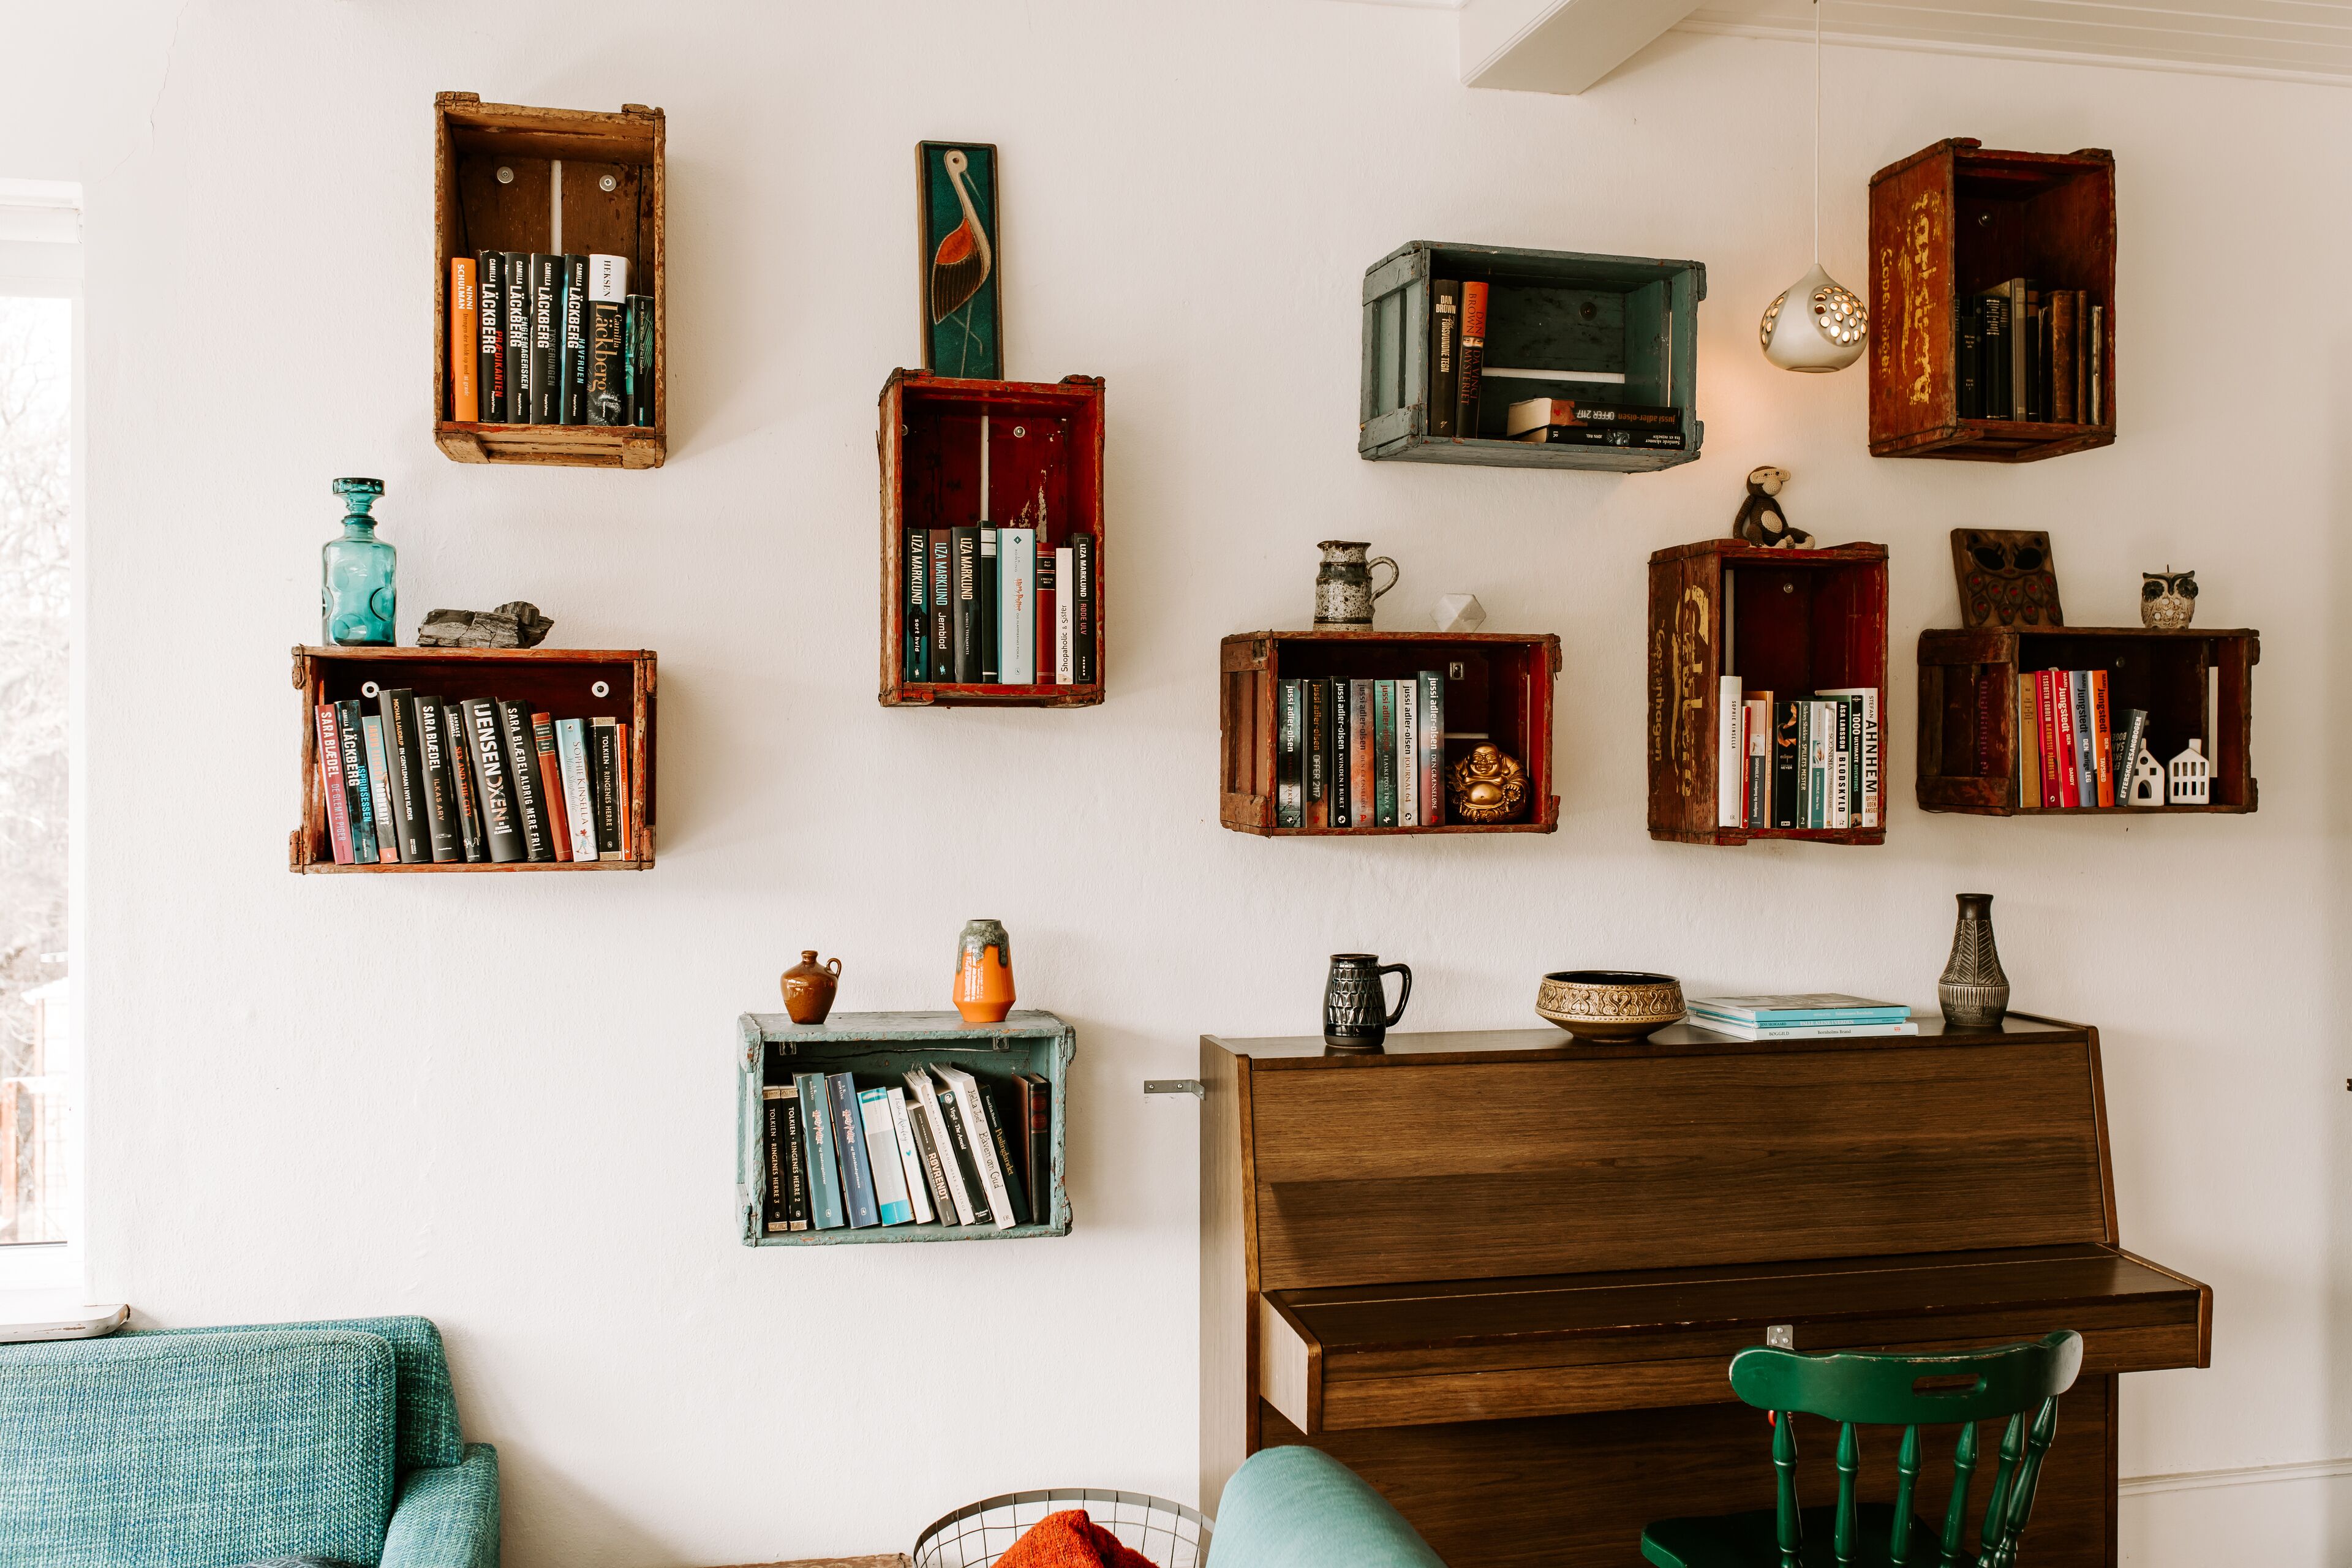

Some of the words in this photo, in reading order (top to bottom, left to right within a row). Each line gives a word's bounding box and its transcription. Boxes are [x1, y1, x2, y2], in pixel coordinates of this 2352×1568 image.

[603, 260, 611, 297] HEKSEN
[1436, 304, 1456, 314] BROWN
[1441, 295, 1452, 304] DAN
[1466, 293, 1477, 333] BROWN
[482, 283, 499, 353] LÄCKBERG
[510, 285, 524, 347] LÄCKBERG
[537, 287, 552, 349] LÄCKBERG
[568, 287, 583, 349] LÄCKBERG
[613, 314, 622, 348] Camilla
[1475, 311, 1483, 334] DAN
[589, 303, 618, 393] Läckberg
[1441, 318, 1451, 356] FORSVUNDNE
[494, 331, 503, 398] PRÆDIKANTEN
[548, 328, 556, 386] TYSKERUNGEN
[577, 338, 586, 383] HAVFRUEN
[1441, 357, 1450, 372] TEGN
[1472, 350, 1481, 364] DA
[1461, 350, 1472, 405] MYSTERIET
[1470, 368, 1480, 399] VINCI
[1576, 410, 1591, 418] 2117
[1593, 410, 1615, 420] OFFER
[911, 535, 924, 552] LIZA
[935, 543, 948, 559] LIZA
[960, 538, 973, 554] LIZA
[911, 556, 922, 605] MARKLUND
[935, 562, 948, 606] MARKLUND
[960, 556, 973, 600] MARKLUND
[1014, 578, 1024, 594] Harry
[1012, 594, 1024, 612] Potter
[938, 612, 947, 649] Jernblod
[1286, 685, 1295, 704] jussi
[1313, 684, 1322, 703] jussi
[1403, 685, 1412, 705] jussi
[1428, 677, 1438, 698] jussi
[321, 712, 336, 737] SARA
[423, 706, 435, 731] SARA
[508, 707, 521, 733] SARA
[1430, 699, 1439, 750] adler-olsen
[1852, 712, 1861, 735] 1000
[2058, 687, 2070, 733] Jungstedt
[2076, 688, 2088, 733] Jungstedt
[2096, 688, 2107, 733] Jungstedt
[395, 722, 404, 745] LAUDRUP
[474, 709, 502, 776] JENSEN
[1287, 706, 1295, 752] adler-olsen
[1313, 705, 1322, 750] adler-olsen
[323, 740, 339, 777] BLÆDEL
[342, 728, 360, 786] LÄCKBERG
[426, 733, 440, 771] BLÆDEL
[513, 736, 528, 774] BLÆDEL
[573, 741, 585, 775] SOPHIE
[1866, 720, 1877, 793] AHNHEM
[2047, 752, 2056, 780] PÅRØRENDE
[2120, 717, 2142, 798] EFTERSKOLESANGBOGEN
[457, 763, 466, 779] AND
[331, 784, 339, 793] DE
[358, 766, 371, 822] ISPRINSESSEN
[375, 783, 390, 825] NORDKRAFT
[434, 779, 442, 802] ILKAS
[460, 782, 469, 797] THE
[520, 776, 533, 805] ALDRIG
[568, 775, 578, 812] Shopaholic
[577, 778, 589, 824] KINSELLA
[1405, 793, 1411, 802] 64
[333, 794, 344, 820] GLEMTE
[462, 799, 472, 817] CITY
[526, 808, 537, 829] MERE
[335, 822, 346, 841] PIGER
[530, 833, 540, 846] FRI
[968, 1089, 979, 1109] Hella
[948, 1107, 958, 1120] Virgil
[956, 1133, 967, 1150] Aeneid
[973, 1110, 984, 1123] Joof
[978, 1131, 992, 1158] Båven
[995, 1128, 1014, 1175] Puslinglandet
[928, 1152, 948, 1200] RØVRENDT
[987, 1159, 995, 1170] om
[990, 1171, 1003, 1189] Gud
